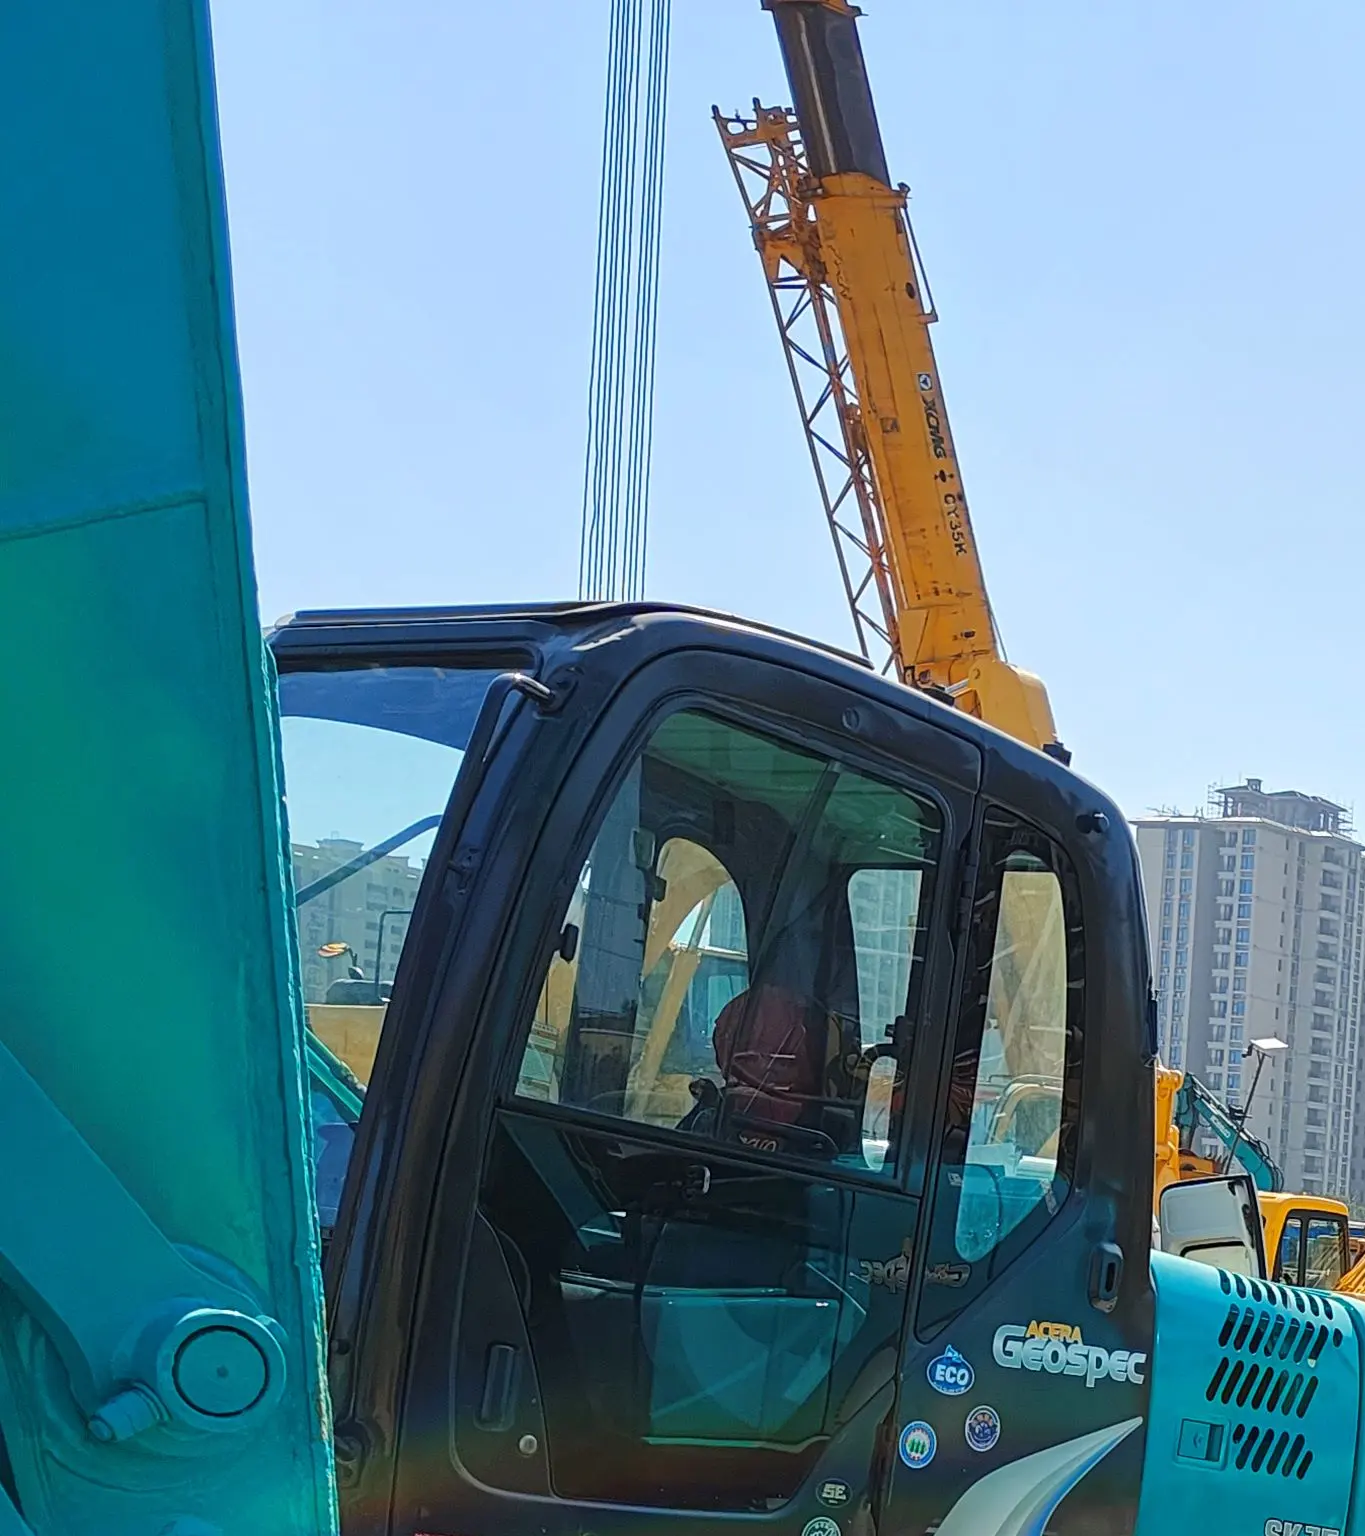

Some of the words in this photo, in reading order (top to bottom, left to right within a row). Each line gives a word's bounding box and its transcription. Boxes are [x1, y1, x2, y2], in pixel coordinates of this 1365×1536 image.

[920, 394, 947, 460] XCMG
[1025, 1319, 1084, 1345] ACERA
[935, 1363, 970, 1386] ECO
